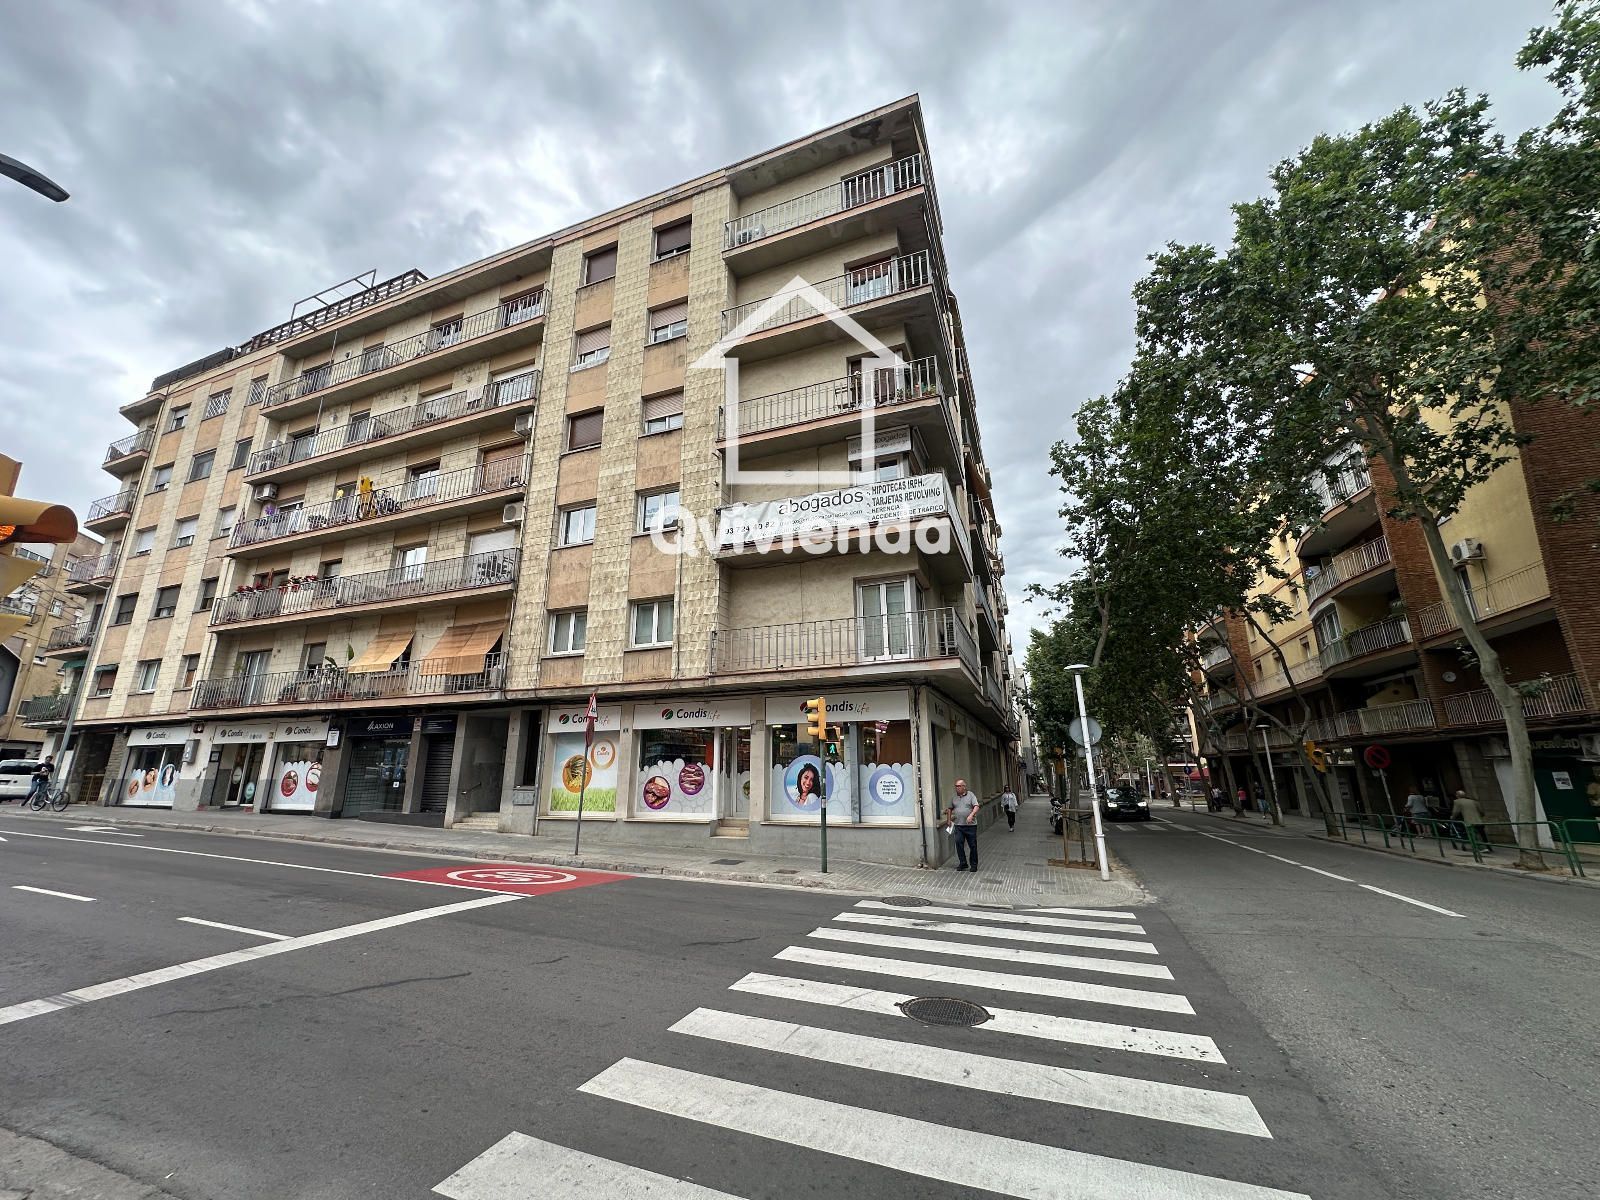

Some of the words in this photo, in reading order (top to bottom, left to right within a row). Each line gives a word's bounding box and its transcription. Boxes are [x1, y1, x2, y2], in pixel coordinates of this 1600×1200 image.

[871, 481, 907, 495] HIPOTECAS
[778, 490, 864, 515] abogados
[871, 493, 903, 507] TARJETAS
[904, 487, 941, 502] REVOLVING
[819, 701, 854, 712] ondis
[676, 708, 707, 719] Condis
[373, 722, 394, 730] AXION
